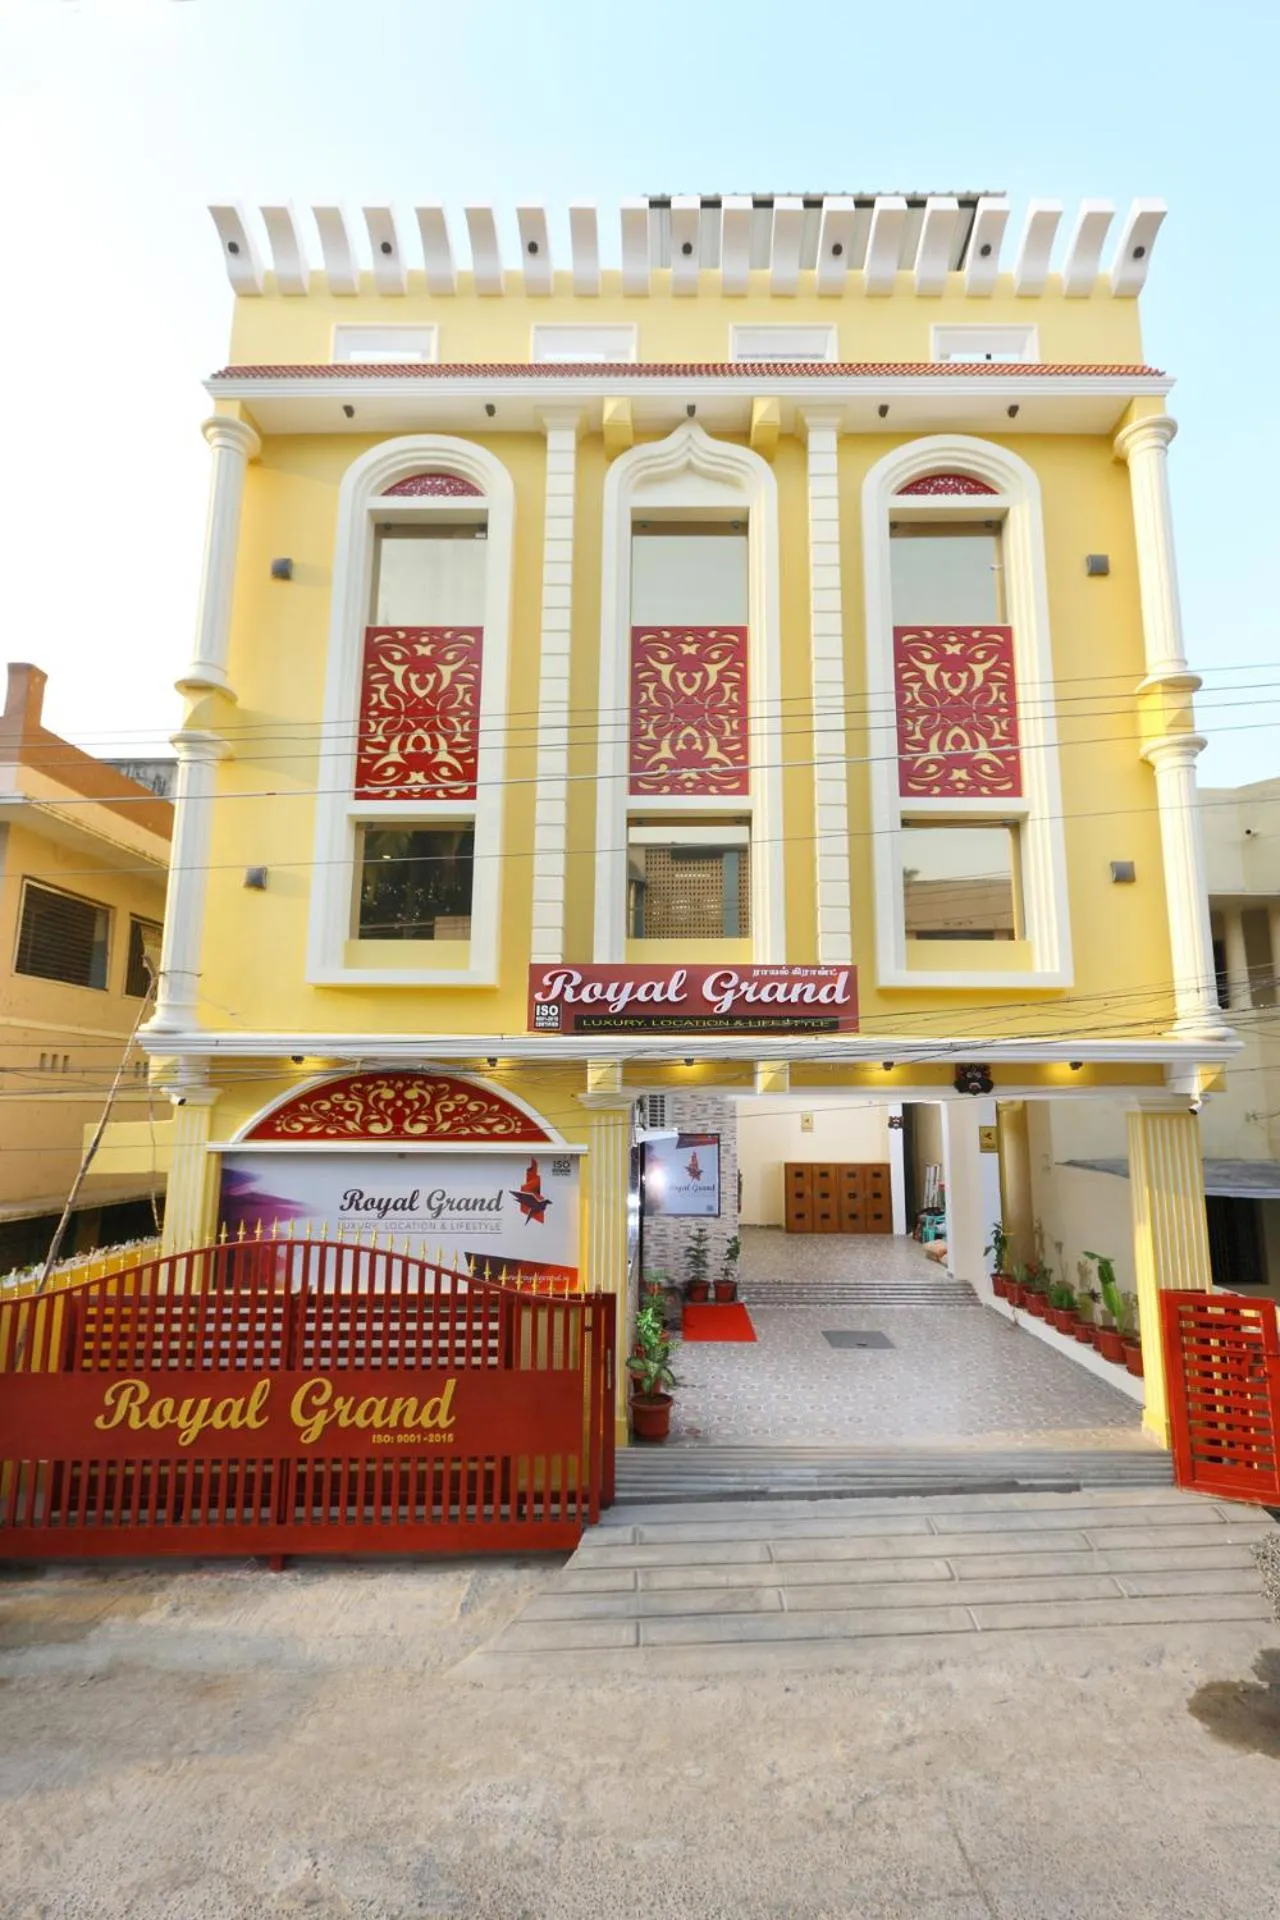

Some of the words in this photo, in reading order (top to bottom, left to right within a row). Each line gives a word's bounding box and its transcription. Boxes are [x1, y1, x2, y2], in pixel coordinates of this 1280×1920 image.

[534, 969, 688, 1014] Royal
[702, 970, 851, 1014] Grand
[536, 1004, 559, 1016] ISO
[652, 1018, 729, 1026] LOCATION
[339, 1188, 419, 1219] Royal
[426, 1188, 504, 1219] Grand
[384, 1221, 436, 1231] LOCATION
[450, 1222, 501, 1231] LIFESTYLE
[95, 1379, 270, 1447] Royal
[290, 1378, 457, 1444] Grand
[372, 1434, 394, 1444] ISO:
